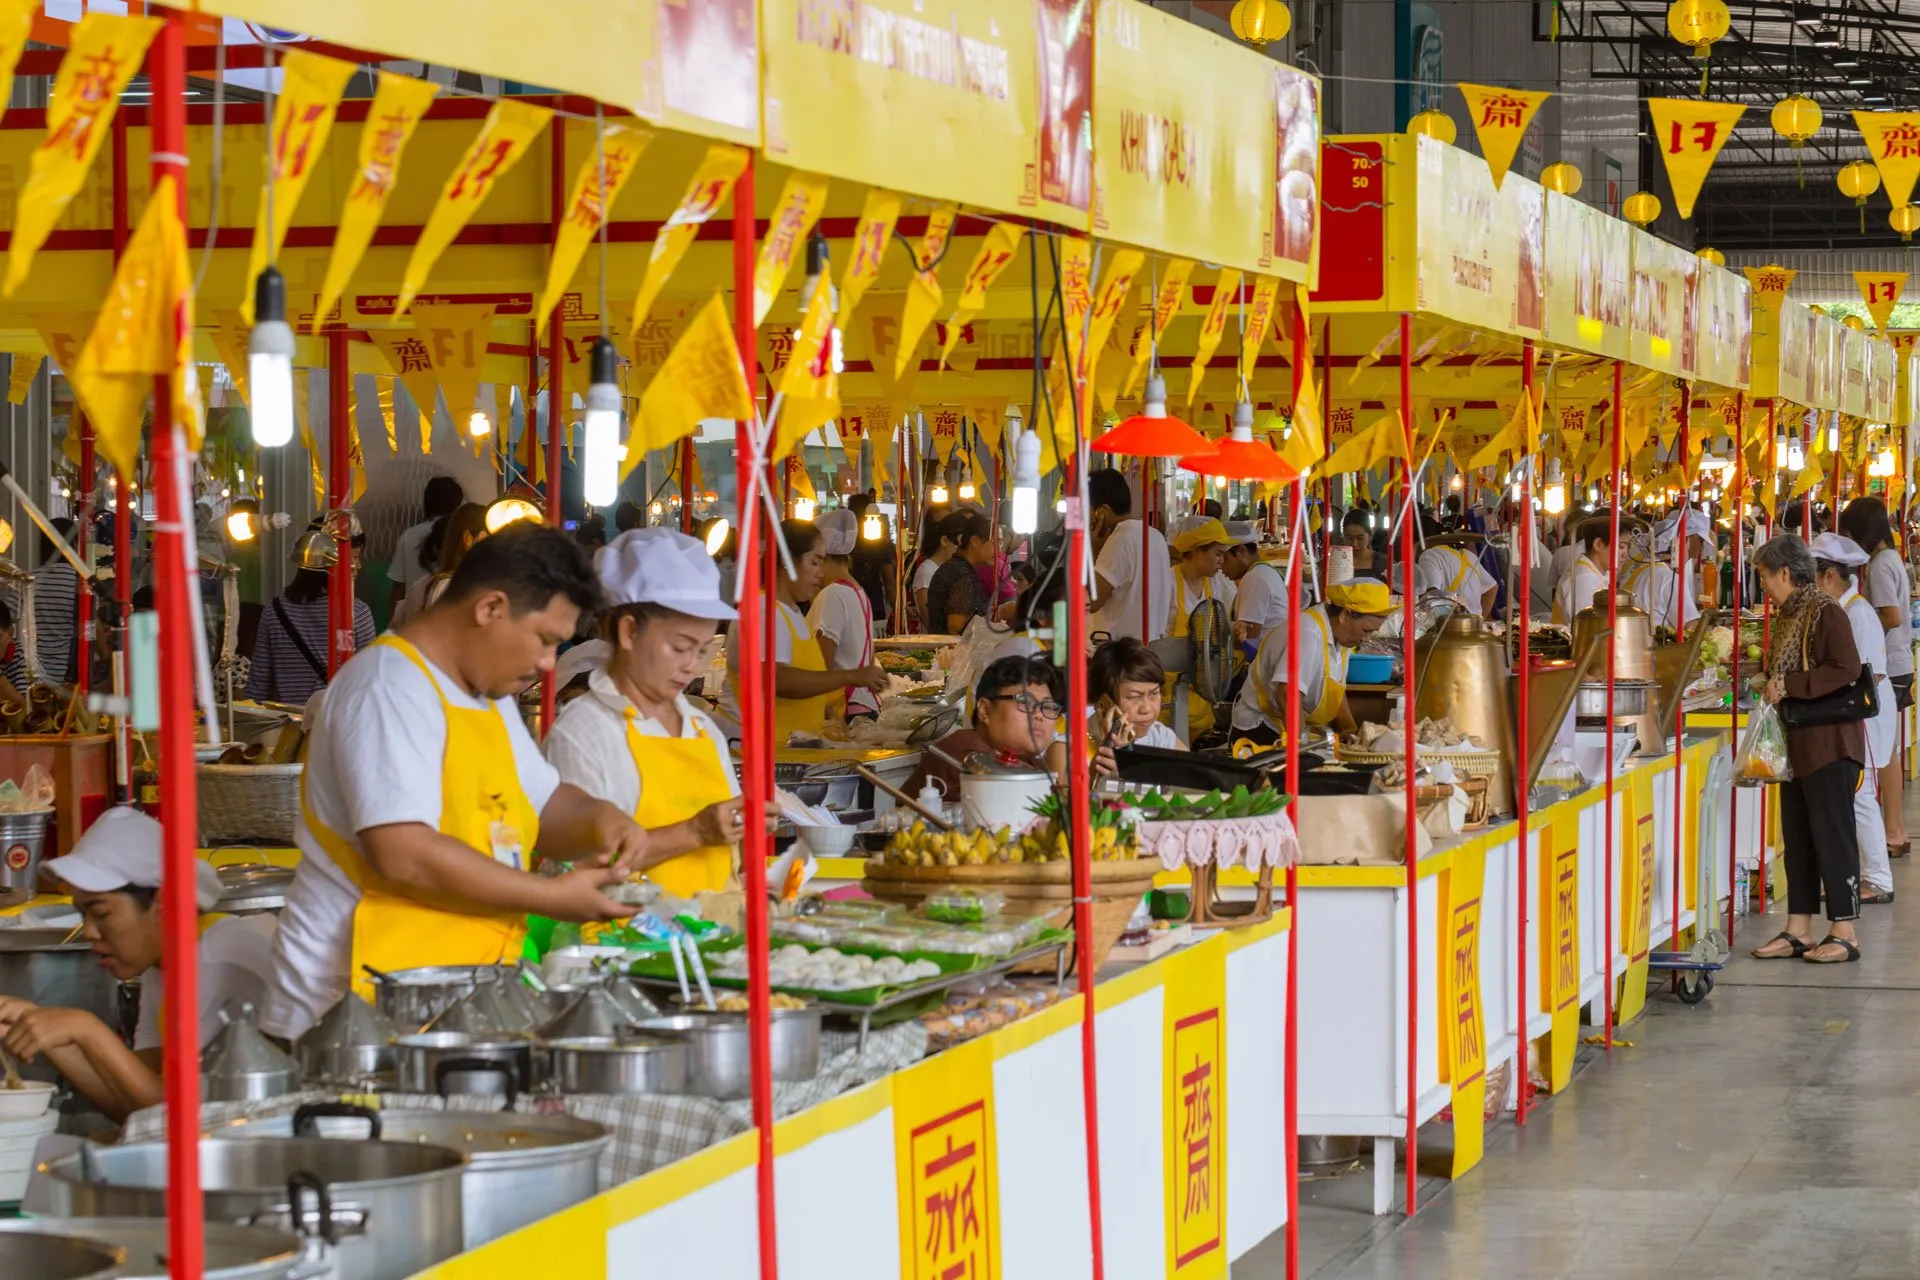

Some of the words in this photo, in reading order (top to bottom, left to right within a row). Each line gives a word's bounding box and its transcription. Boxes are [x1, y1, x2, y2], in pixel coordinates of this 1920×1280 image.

[1479, 93, 1530, 129] 齋
[1352, 176, 1369, 188] 50
[1757, 272, 1787, 292] 齋
[391, 338, 433, 373] 齋
[934, 410, 959, 438] 齋
[1330, 407, 1355, 434] 齋
[1560, 405, 1585, 430] 齋
[1558, 863, 1575, 990] 齋
[1454, 914, 1479, 1067] 齋
[1181, 1053, 1212, 1223] 齋
